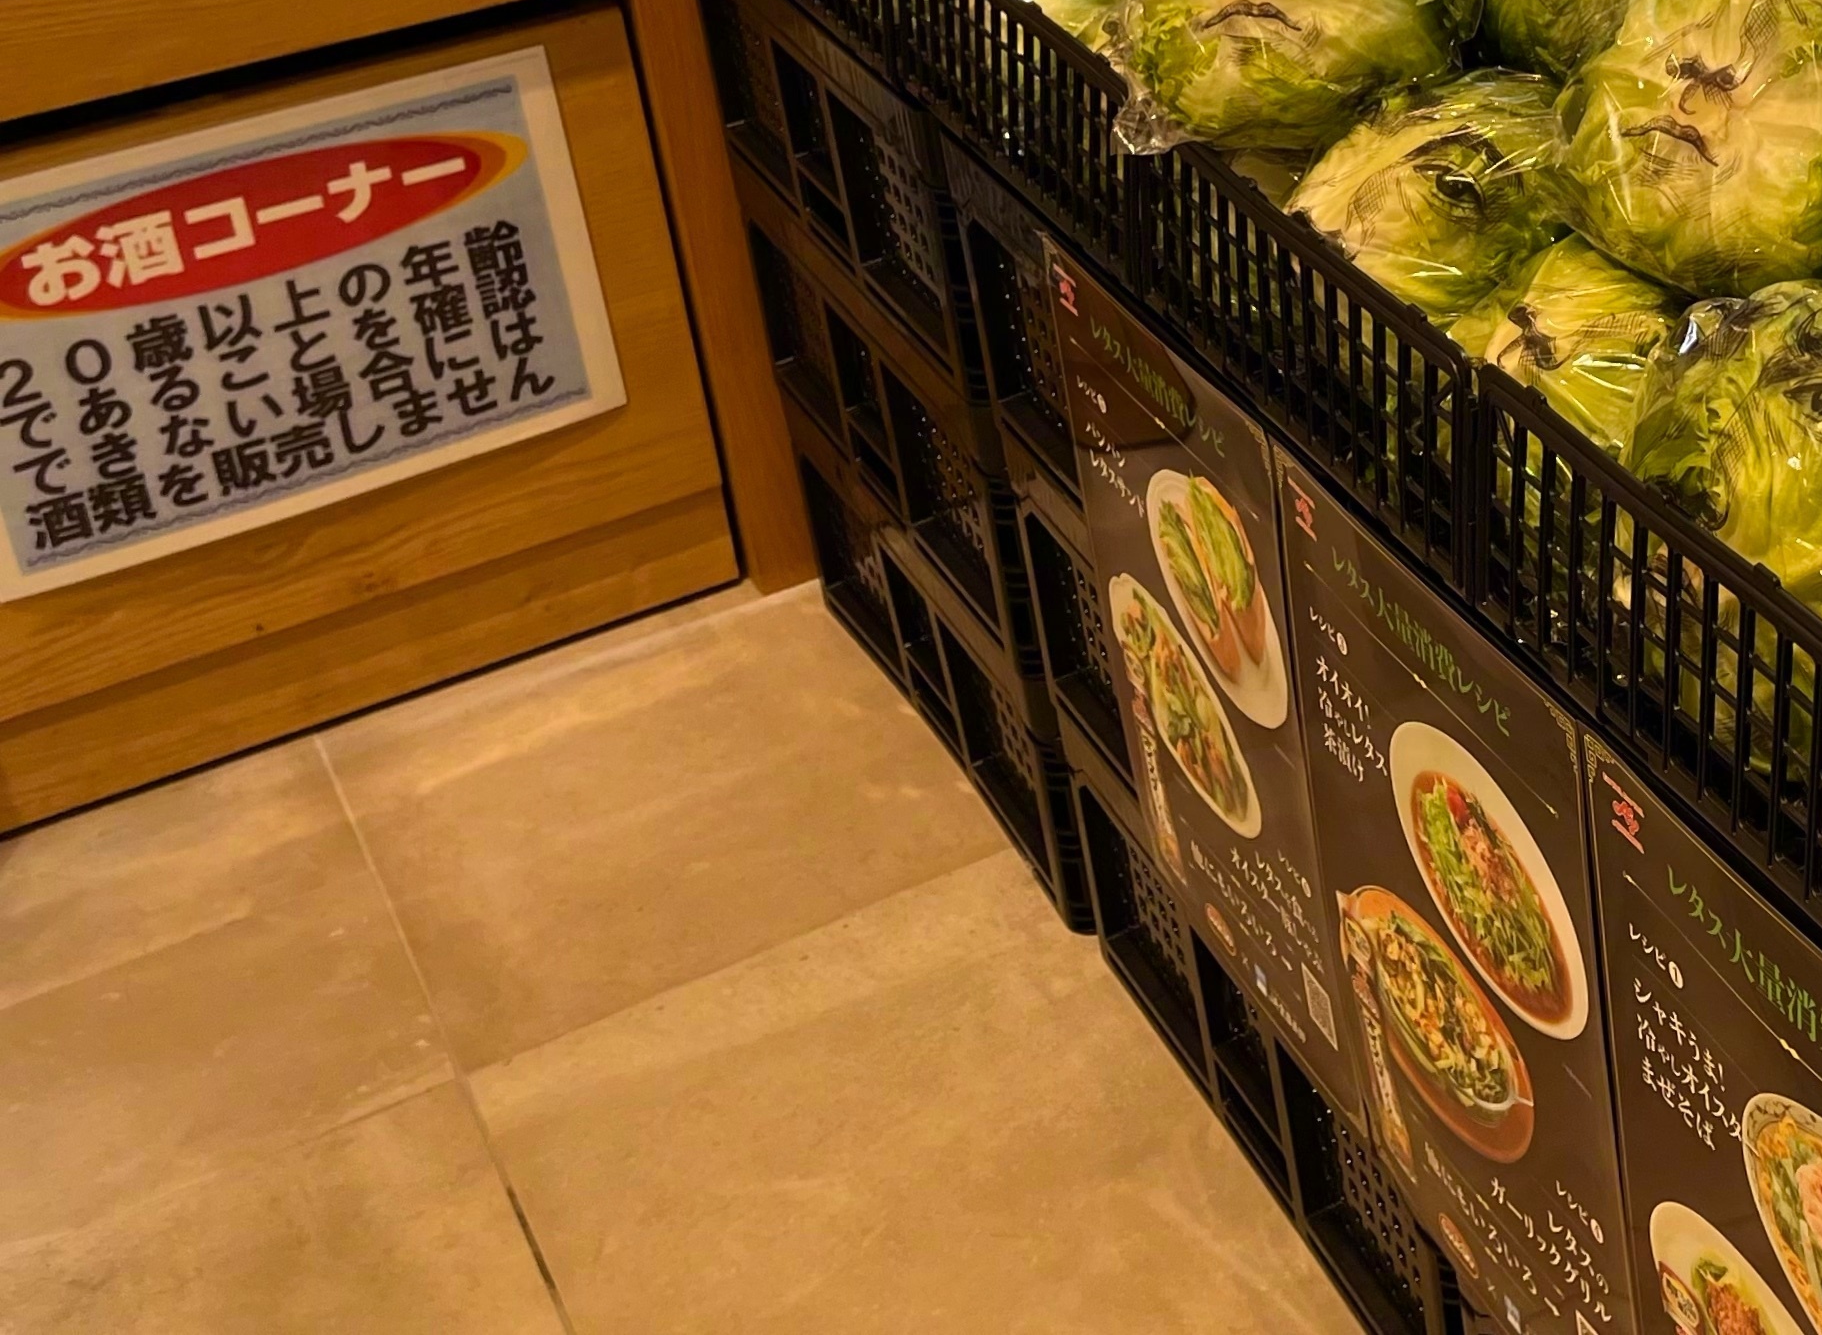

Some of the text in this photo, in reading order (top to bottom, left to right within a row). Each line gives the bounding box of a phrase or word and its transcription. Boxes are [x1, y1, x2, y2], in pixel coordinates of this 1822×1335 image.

[22, 156, 466, 307] お酒コーナー
[14, 314, 543, 496] できない場合には
[27, 363, 555, 550] 酒類を販売しません
[1332, 546, 1511, 737] レタス大量消費レシピ
[1641, 1056, 1716, 1152] まぜそば
